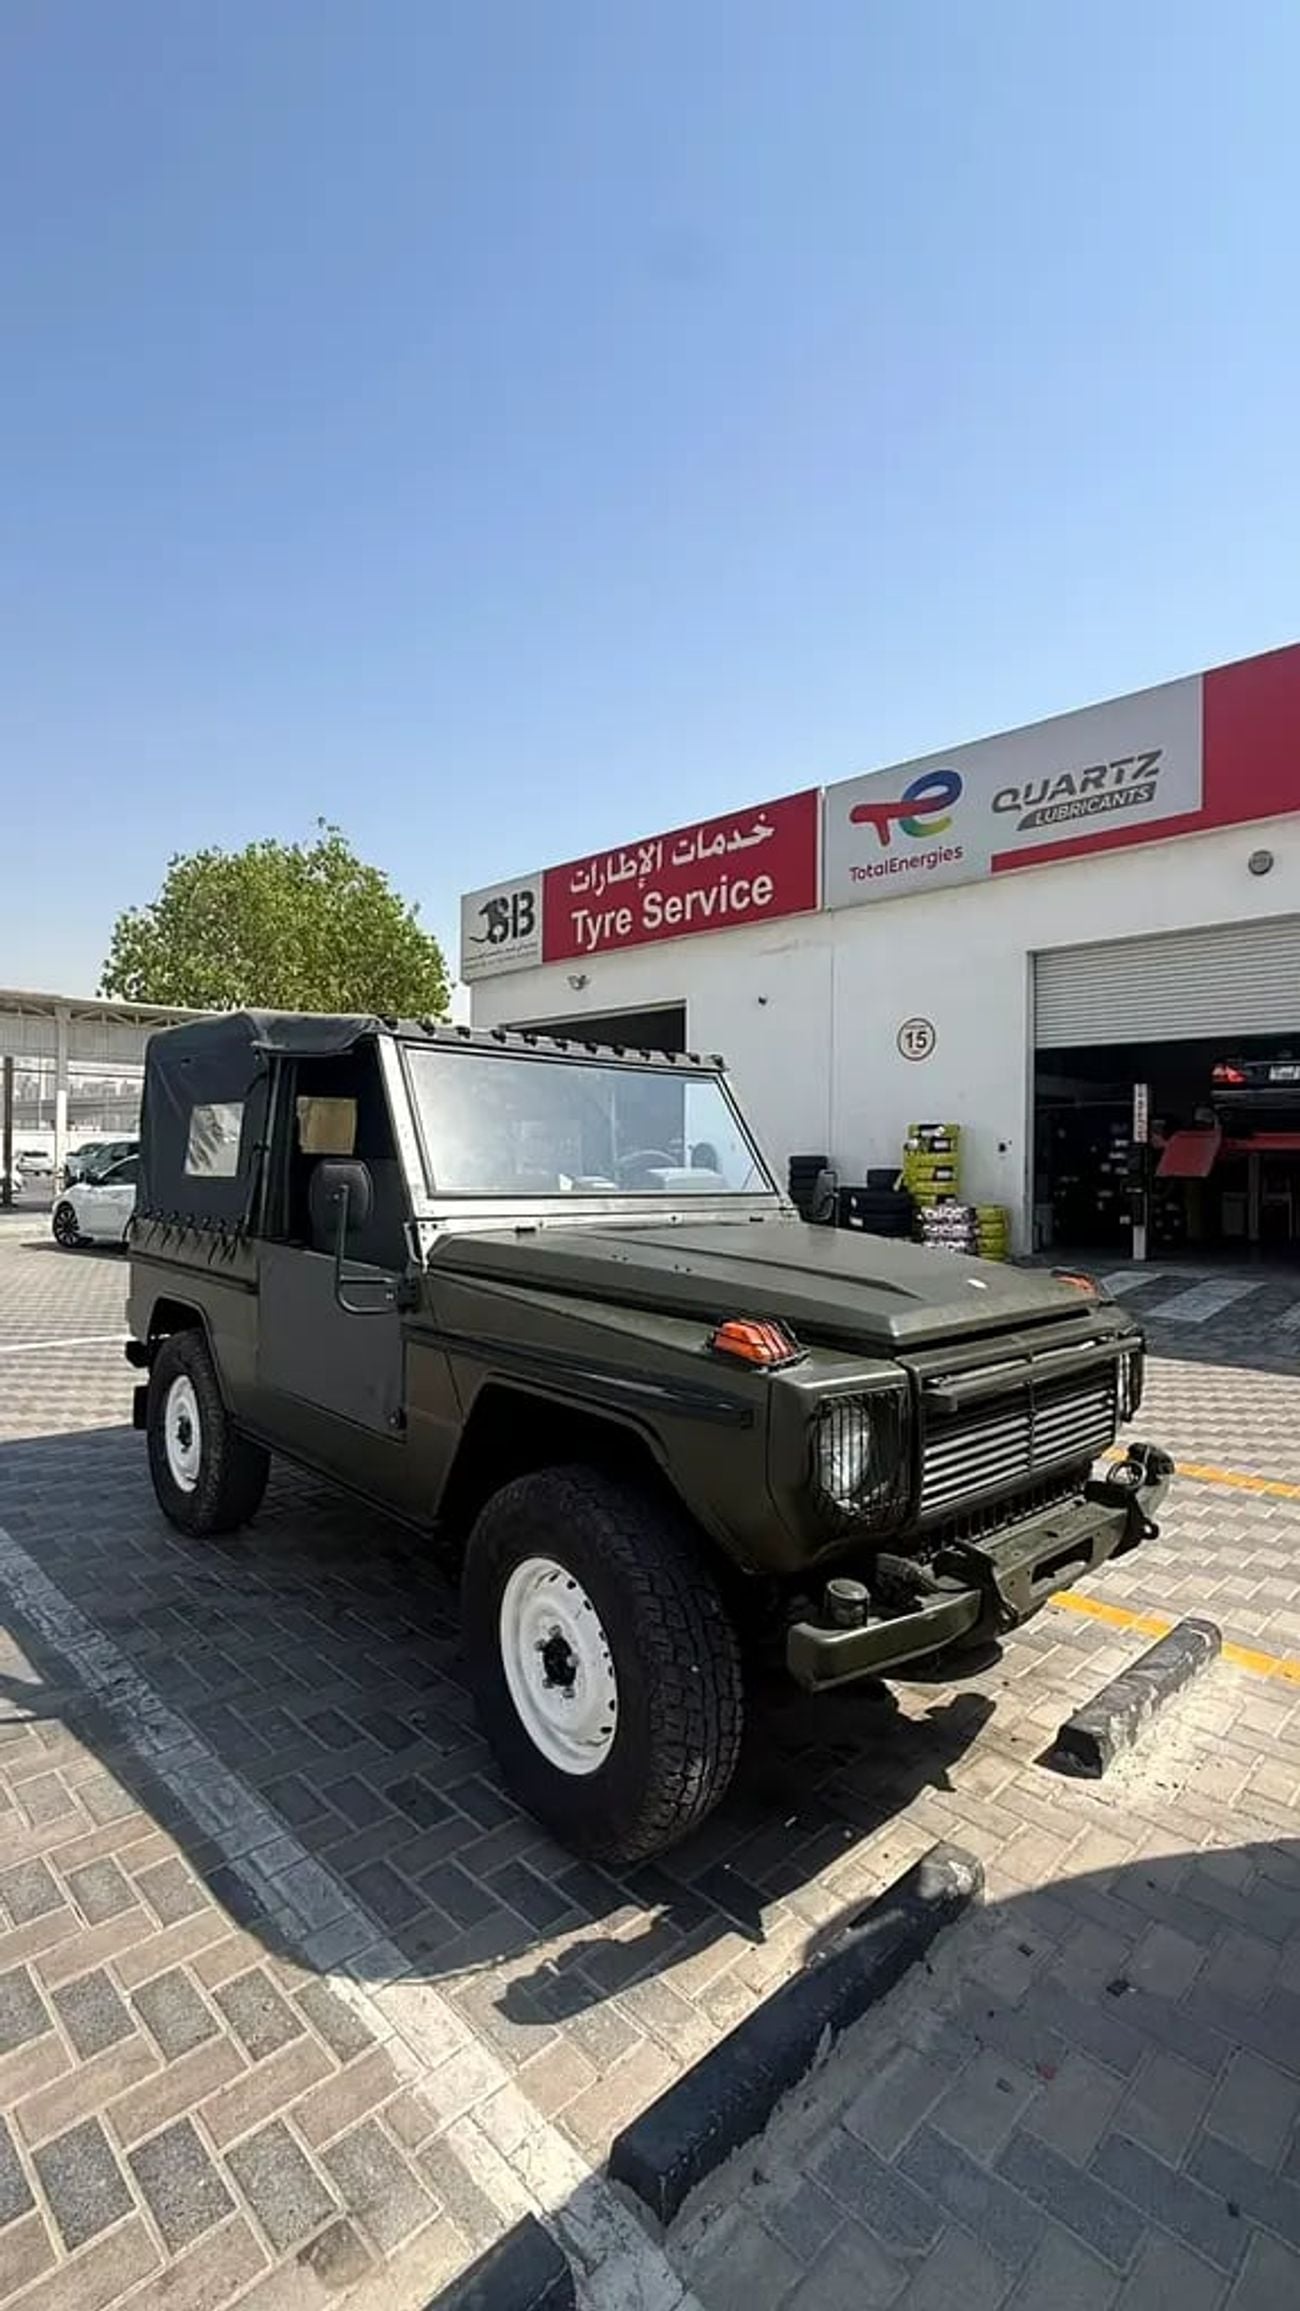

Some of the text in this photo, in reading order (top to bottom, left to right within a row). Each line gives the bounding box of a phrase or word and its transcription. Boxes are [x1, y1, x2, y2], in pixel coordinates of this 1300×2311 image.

[991, 749, 1163, 813] QUARTZ
[1035, 783, 1152, 827] LUBRICANTS
[569, 812, 776, 897] خدمات الإطارات
[849, 844, 964, 883] TotalEnergies
[571, 873, 774, 951] Tyre Service
[904, 1030, 927, 1049] 15
